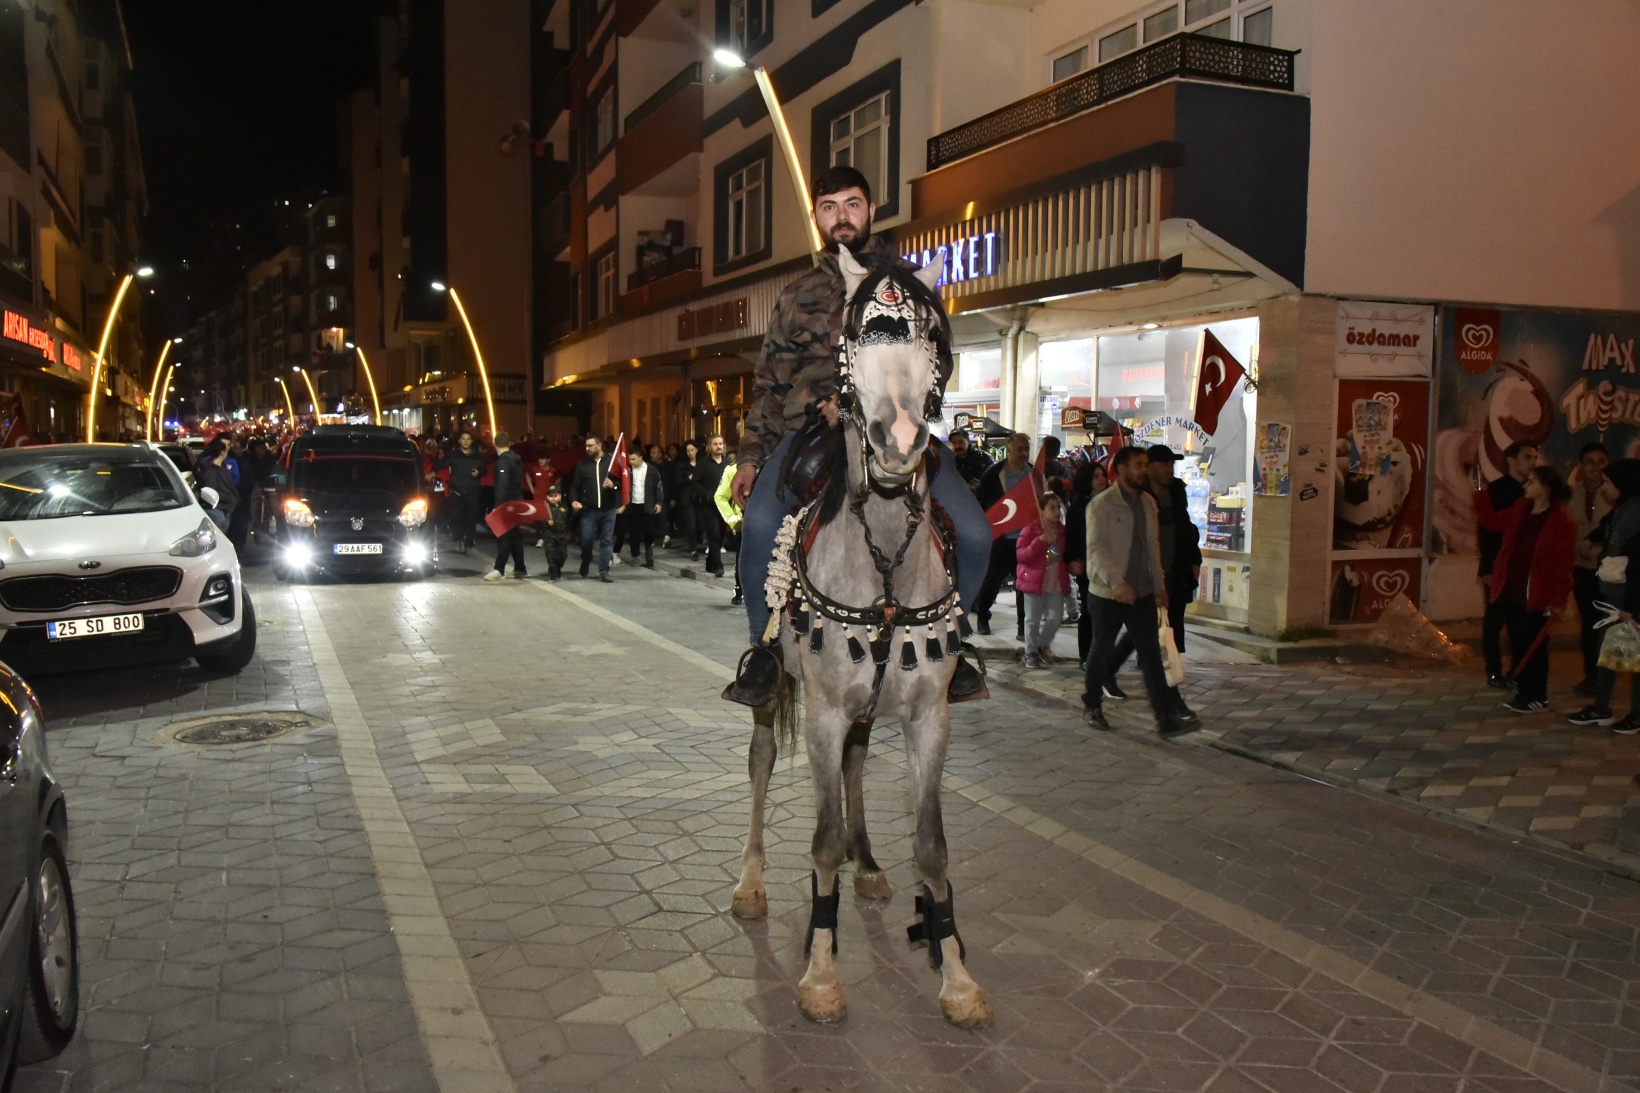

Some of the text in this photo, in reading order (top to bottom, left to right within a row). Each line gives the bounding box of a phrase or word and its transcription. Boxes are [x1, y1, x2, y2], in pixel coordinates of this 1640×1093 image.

[1345, 325, 1420, 348] özdamar
[1582, 332, 1636, 374] MAX
[1175, 417, 1210, 446] MARKET
[338, 545, 349, 553] 29
[58, 615, 140, 637] 25 SD 800
